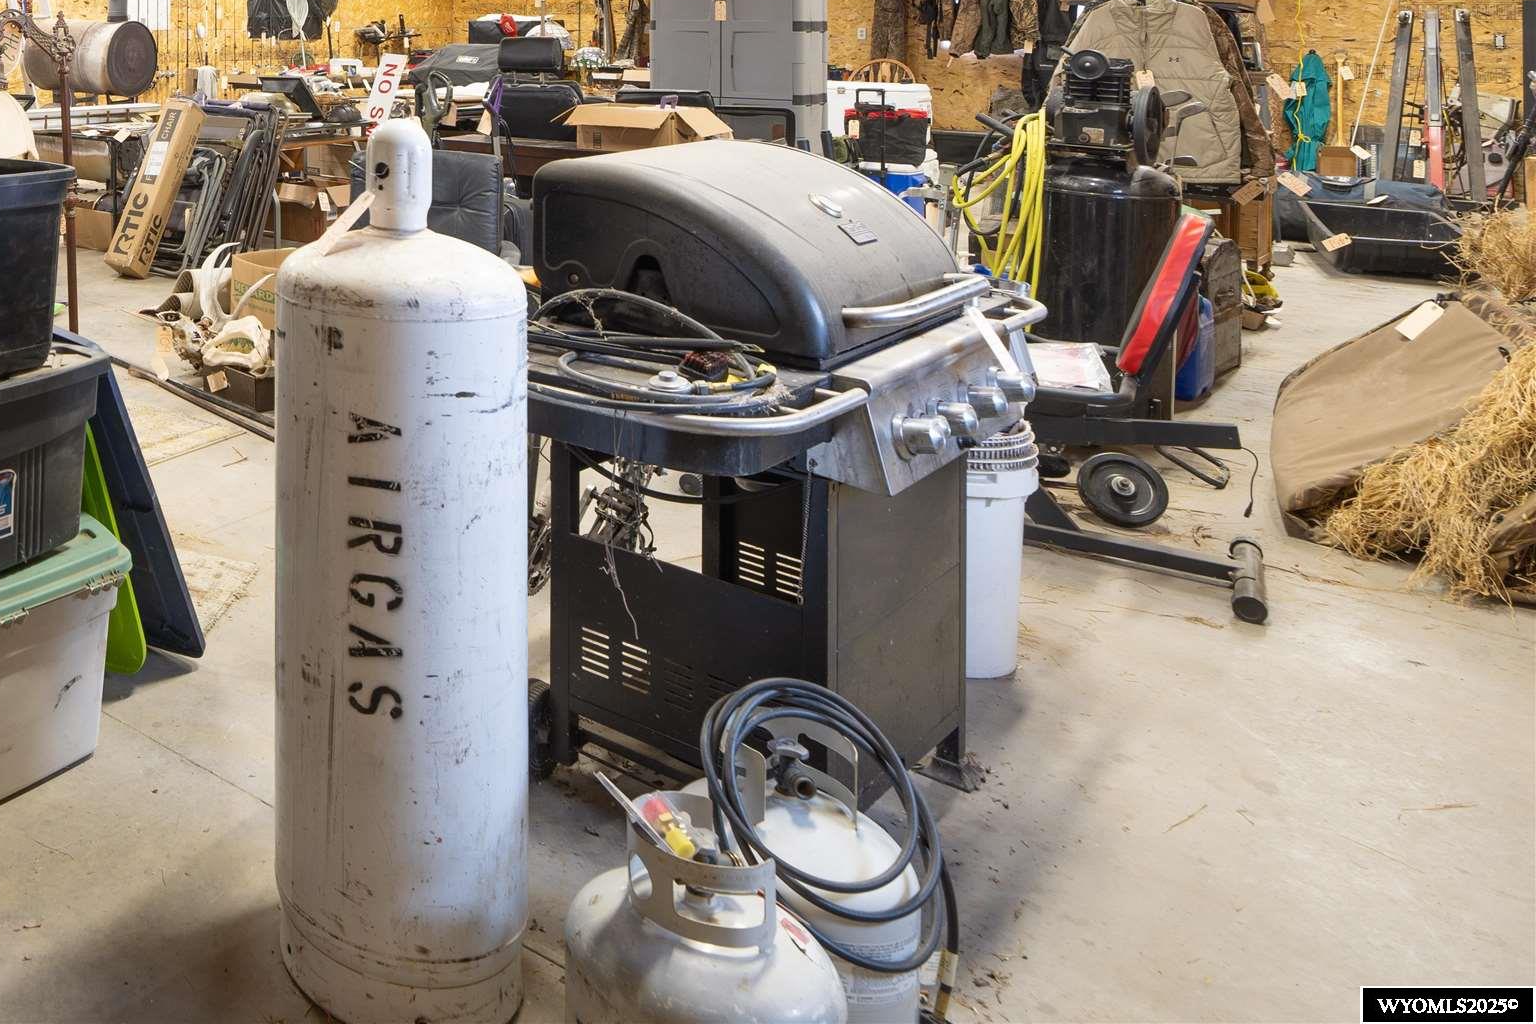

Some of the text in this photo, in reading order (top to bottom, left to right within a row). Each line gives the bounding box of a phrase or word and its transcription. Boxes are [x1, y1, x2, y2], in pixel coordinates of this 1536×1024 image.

[378, 63, 398, 94] NO
[161, 112, 176, 139] CHAIR
[113, 192, 148, 255] RTIC
[138, 214, 162, 265] RTIC
[348, 412, 403, 720] AIRGAS
